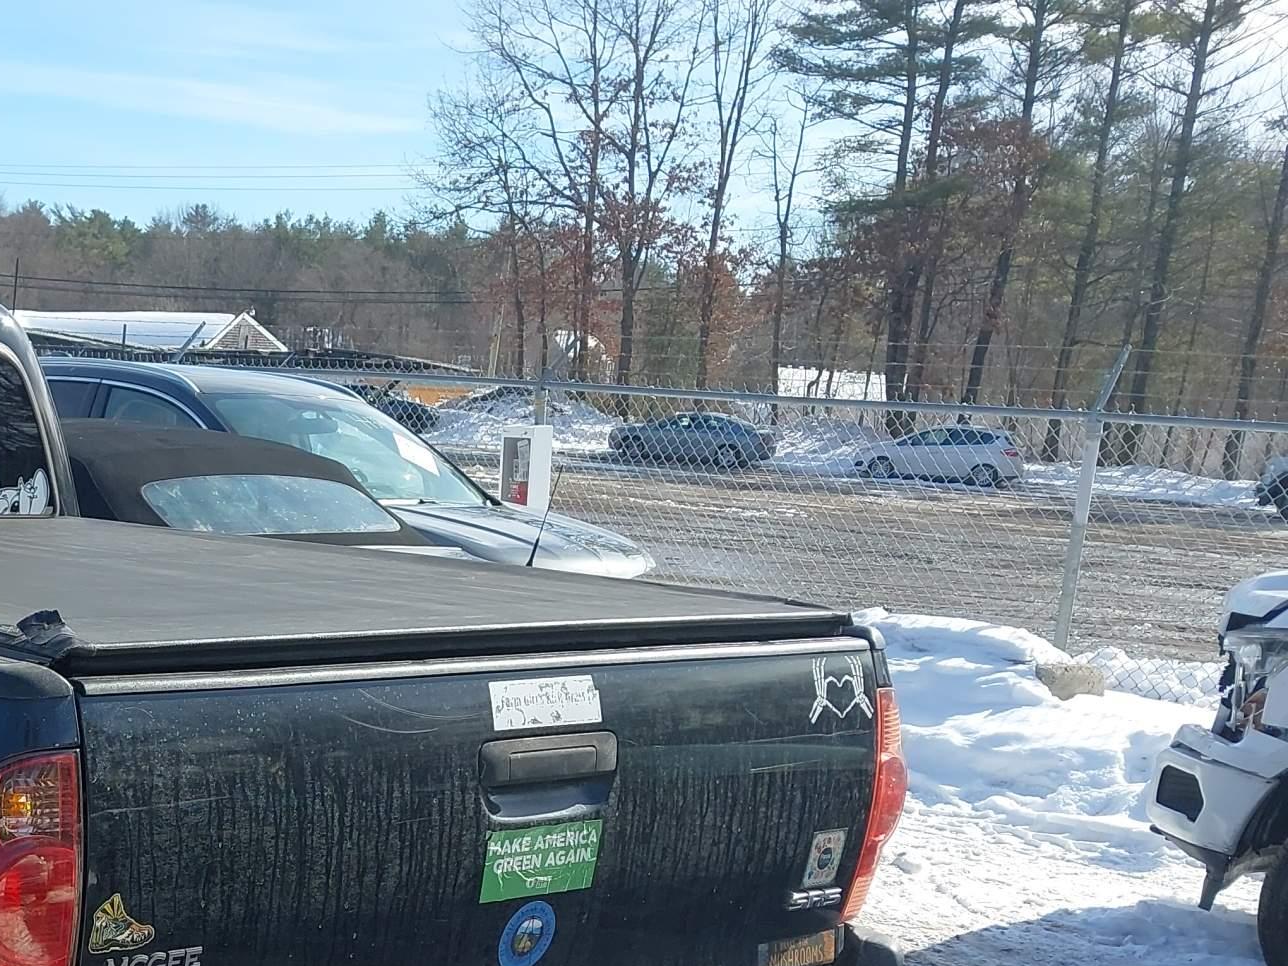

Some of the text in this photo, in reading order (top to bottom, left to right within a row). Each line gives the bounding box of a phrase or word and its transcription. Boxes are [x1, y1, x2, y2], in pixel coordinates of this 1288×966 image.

[489, 828, 597, 857] MAKE AMERICA
[493, 847, 592, 874] GREEN AGAIN
